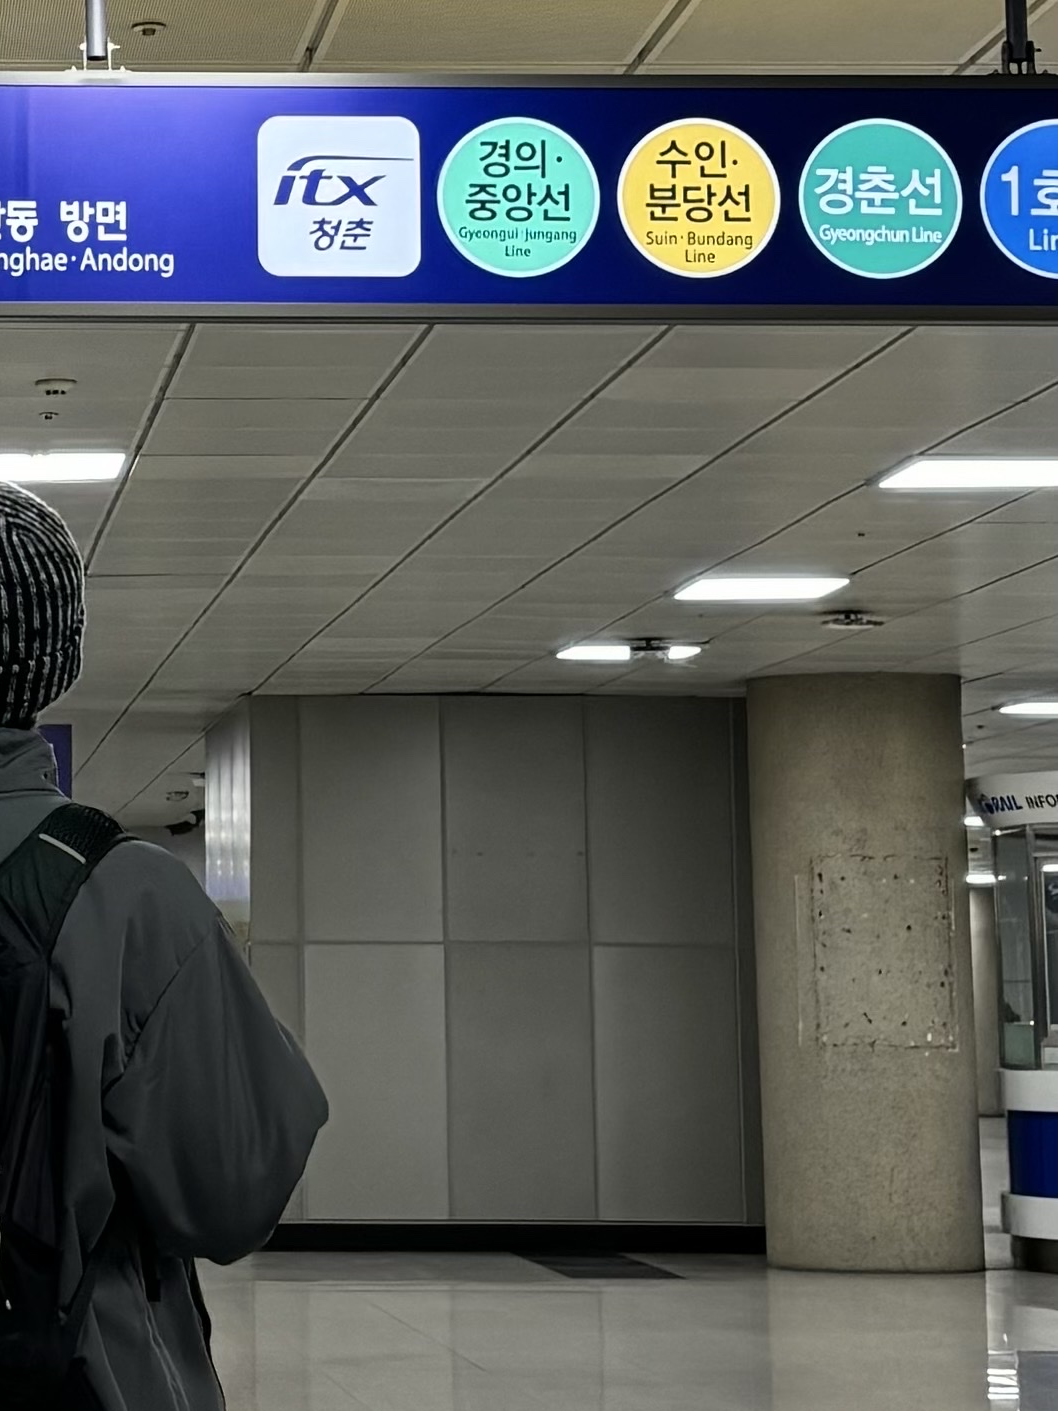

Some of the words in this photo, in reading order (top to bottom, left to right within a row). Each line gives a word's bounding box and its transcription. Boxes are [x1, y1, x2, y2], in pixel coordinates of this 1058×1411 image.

[465, 182, 571, 222] 중앙선
[645, 183, 752, 223] 분당선
[813, 165, 943, 216] 경춘선
[59, 199, 128, 244] 방면
[309, 217, 374, 252] 청춘
[818, 224, 909, 245] Gyeongchun
[911, 226, 943, 243] Line
[504, 245, 531, 257] Line
[684, 249, 716, 264] Line
